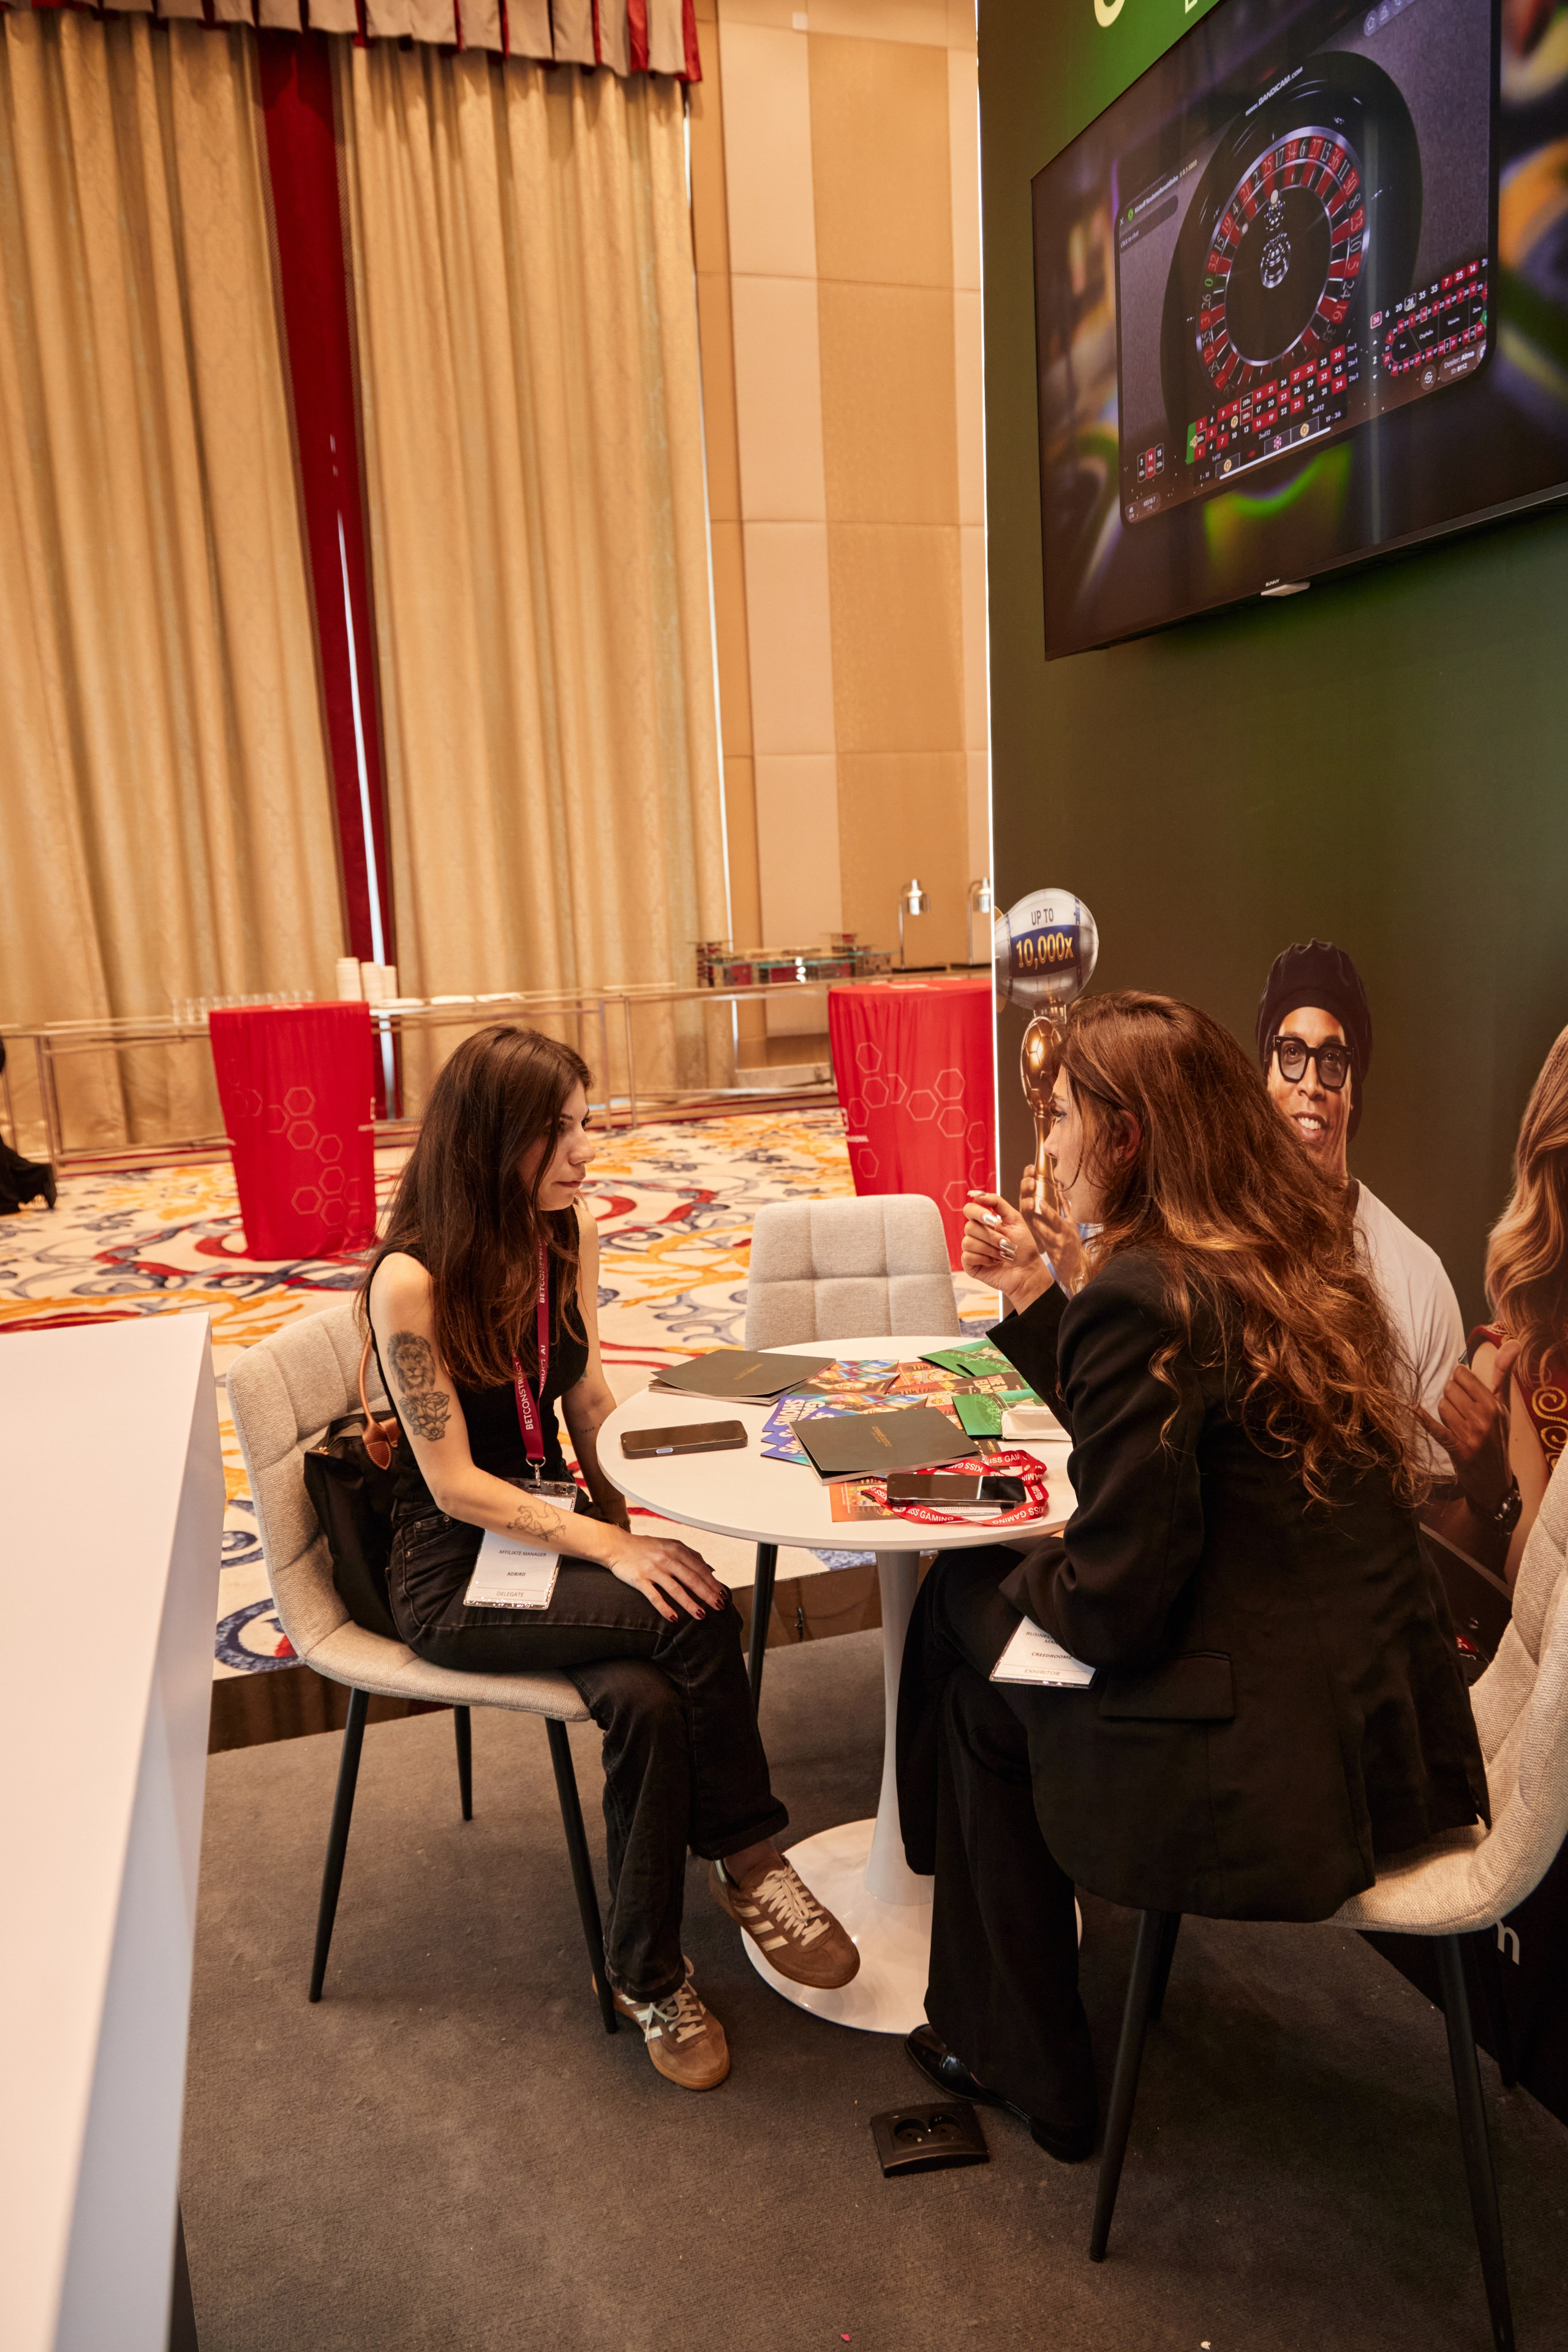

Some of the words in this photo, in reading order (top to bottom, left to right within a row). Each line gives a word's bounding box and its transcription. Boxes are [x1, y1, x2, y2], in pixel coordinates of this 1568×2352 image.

[1299, 139, 1308, 157] 6
[1320, 141, 1332, 162] 13
[1275, 147, 1284, 168] 17
[1329, 148, 1343, 170] 36
[1262, 156, 1273, 179] 25
[1349, 193, 1360, 209] 8
[1221, 217, 1231, 234] 19
[1350, 209, 1363, 231] 23
[1214, 234, 1224, 252] 15
[1350, 234, 1362, 252] 10
[1348, 261, 1359, 271] 5
[1395, 303, 1403, 312] 20
[1419, 290, 1426, 300] 35
[1430, 284, 1438, 294] 35
[1444, 278, 1449, 287] 7
[1456, 271, 1463, 281] 25
[1469, 264, 1476, 273] 14
[1202, 294, 1212, 309] 26
[1333, 304, 1346, 320] 16
[1373, 356, 1377, 364] 2
[1461, 350, 1475, 361] Alma
[1281, 379, 1287, 387] 24
[1294, 372, 1300, 380] 27
[1306, 365, 1314, 374] 30
[1320, 358, 1327, 366] 33
[1334, 350, 1341, 360] 36
[1268, 399, 1274, 407] 20
[1281, 392, 1287, 401] 23
[1294, 386, 1300, 394] 26
[1307, 379, 1314, 388] 29
[1321, 372, 1327, 381] 32
[1335, 365, 1342, 374] 35
[1281, 407, 1287, 416] 22
[1294, 401, 1300, 409] 25
[1307, 394, 1314, 402] 28
[1321, 387, 1327, 396] 31
[1336, 380, 1343, 389] 34
[1031, 910, 1041, 925] UP
[1043, 907, 1054, 923] TO
[1016, 932, 1074, 971] 10,000x
[540, 1345, 546, 1355] AI
[987, 1374, 1006, 1387] THE
[515, 1361, 534, 1431] BETCONSTRUCT
[773, 1399, 805, 1426] SHOWS
[964, 1462, 984, 1472] KISS
[989, 1456, 1003, 1464] ISS
[1005, 1453, 1020, 1463] GAM
[906, 1507, 920, 1517] KISS
[919, 1510, 954, 1522] GAMING
[992, 1510, 1027, 1525] GAMING
[1028, 1506, 1044, 1516] KISS
